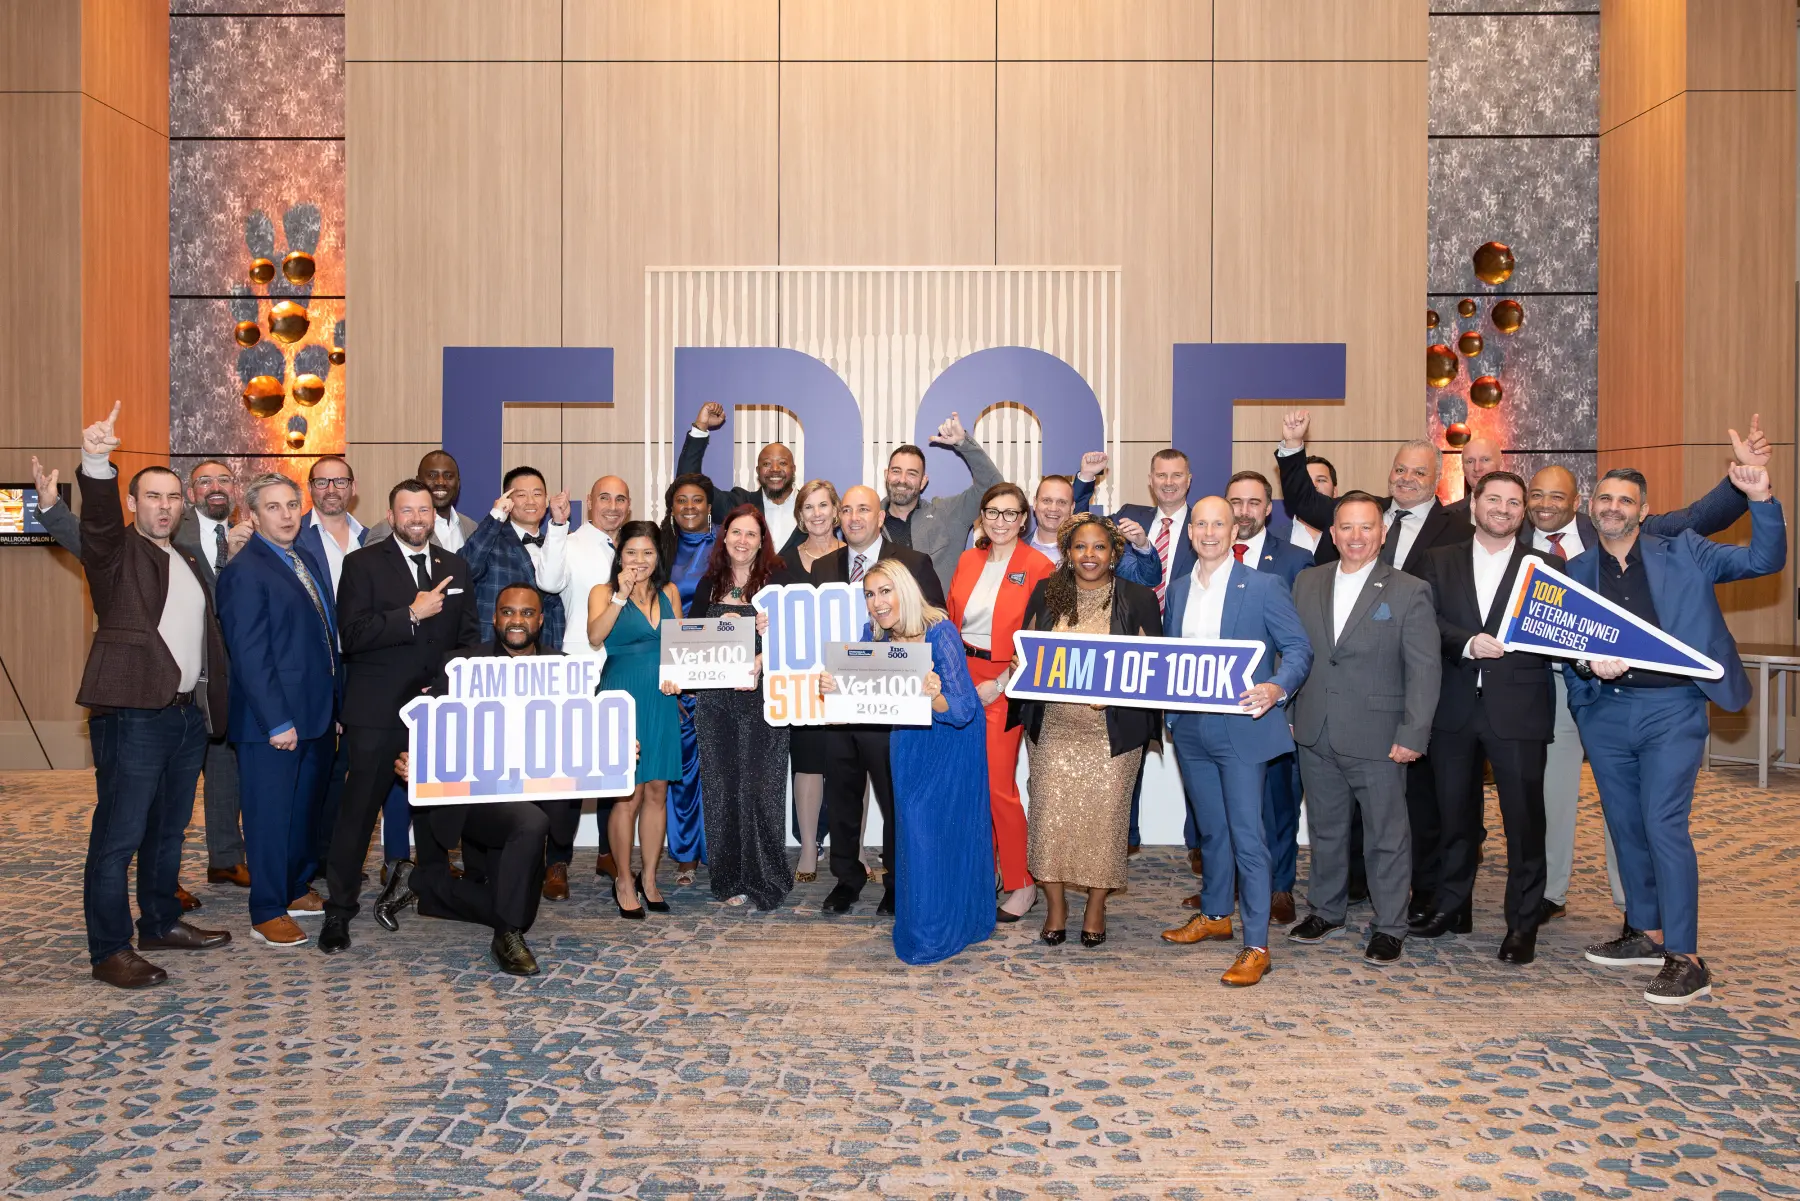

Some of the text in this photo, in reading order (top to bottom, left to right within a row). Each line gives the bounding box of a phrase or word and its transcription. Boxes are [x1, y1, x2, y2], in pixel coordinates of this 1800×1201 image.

[1532, 580, 1567, 608] 100K
[1521, 616, 1589, 651] BUSINESSES
[1528, 601, 1620, 644] VETERAN-OWNED
[669, 645, 746, 666] Vet100
[469, 663, 507, 698] AM
[514, 662, 560, 697] ONE
[566, 661, 594, 694] OF
[688, 671, 726, 681] 2026
[834, 675, 921, 697] Vet100
[1033, 646, 1238, 699] I AM 1 OF 100K
[857, 703, 899, 715] 2026
[408, 697, 629, 788] 100,000
